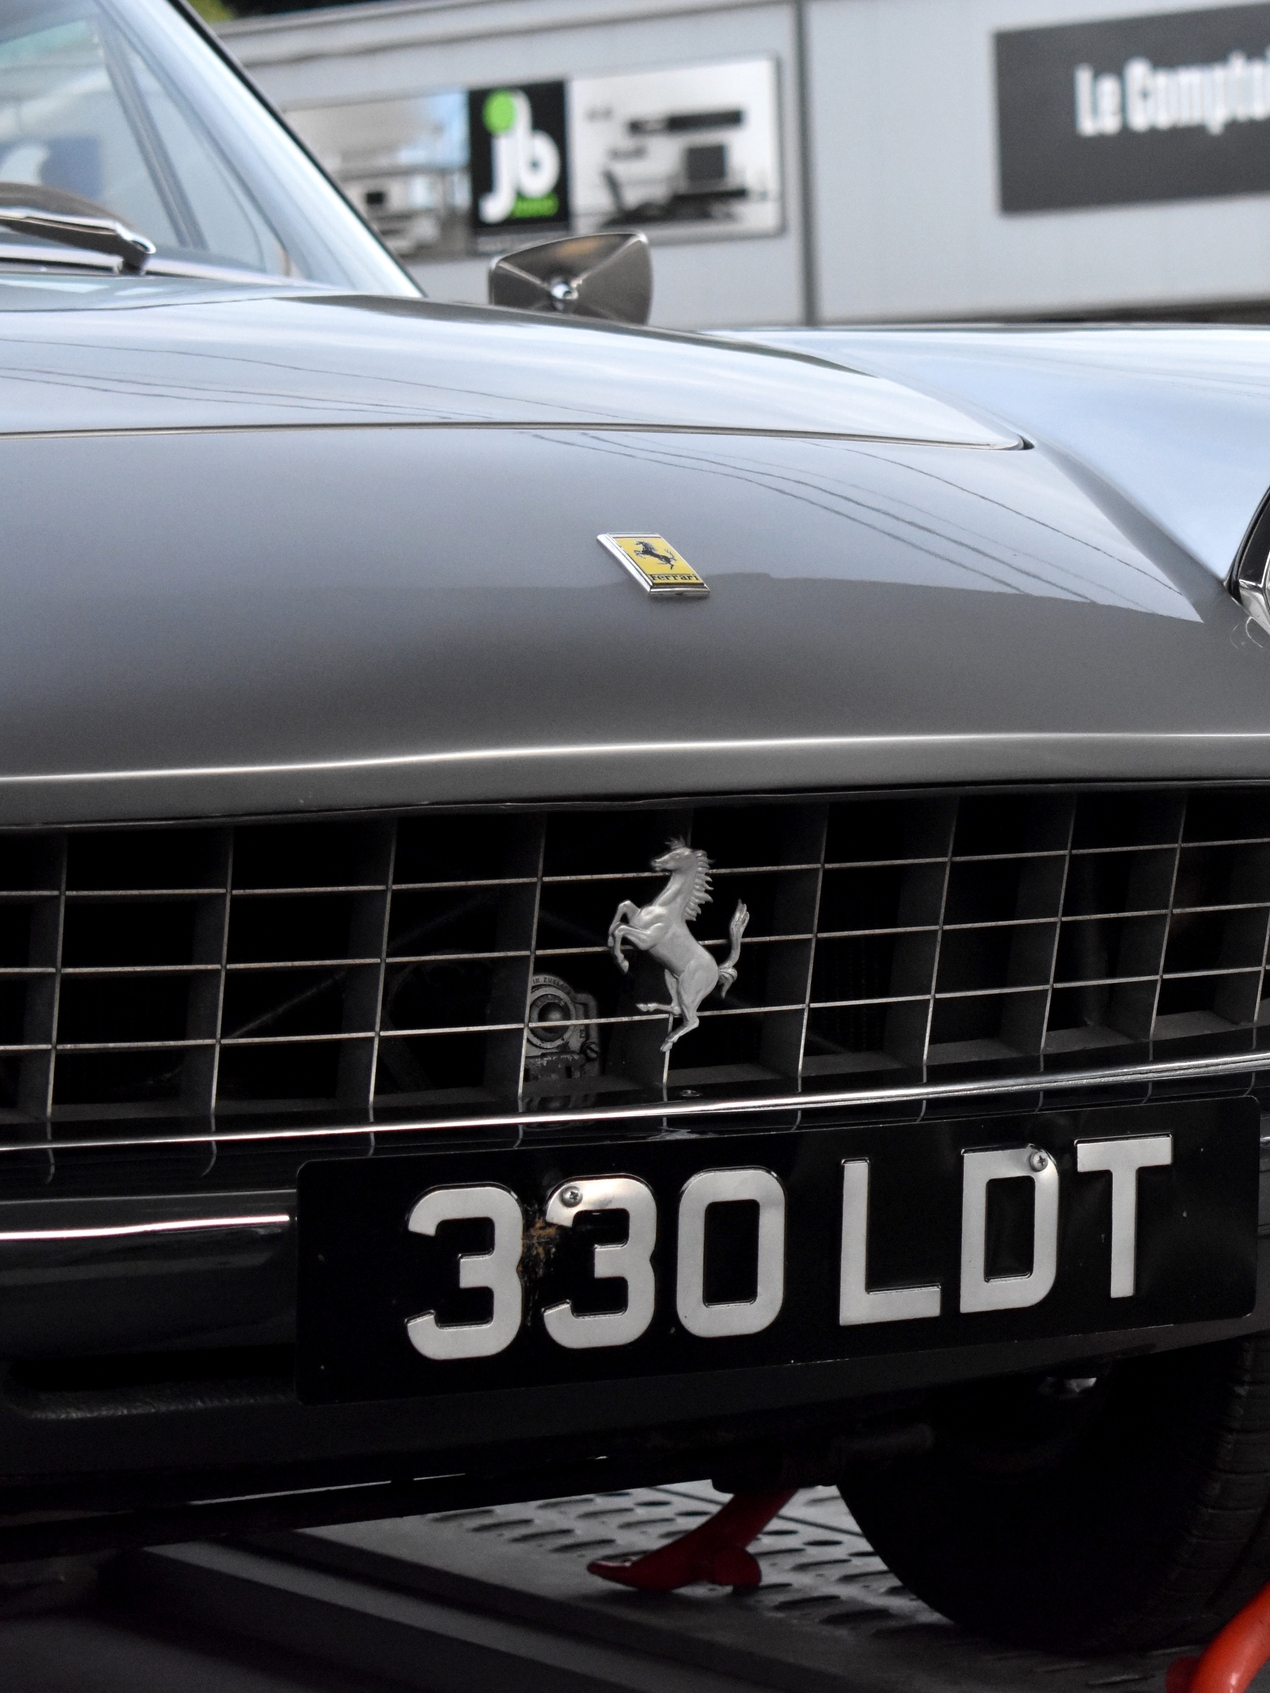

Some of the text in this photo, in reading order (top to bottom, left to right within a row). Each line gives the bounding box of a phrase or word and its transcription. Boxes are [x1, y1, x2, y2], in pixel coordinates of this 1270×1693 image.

[1076, 63, 1122, 136] Le
[650, 573, 700, 581] Ferrari
[406, 1133, 1172, 1360] 330 LDT
